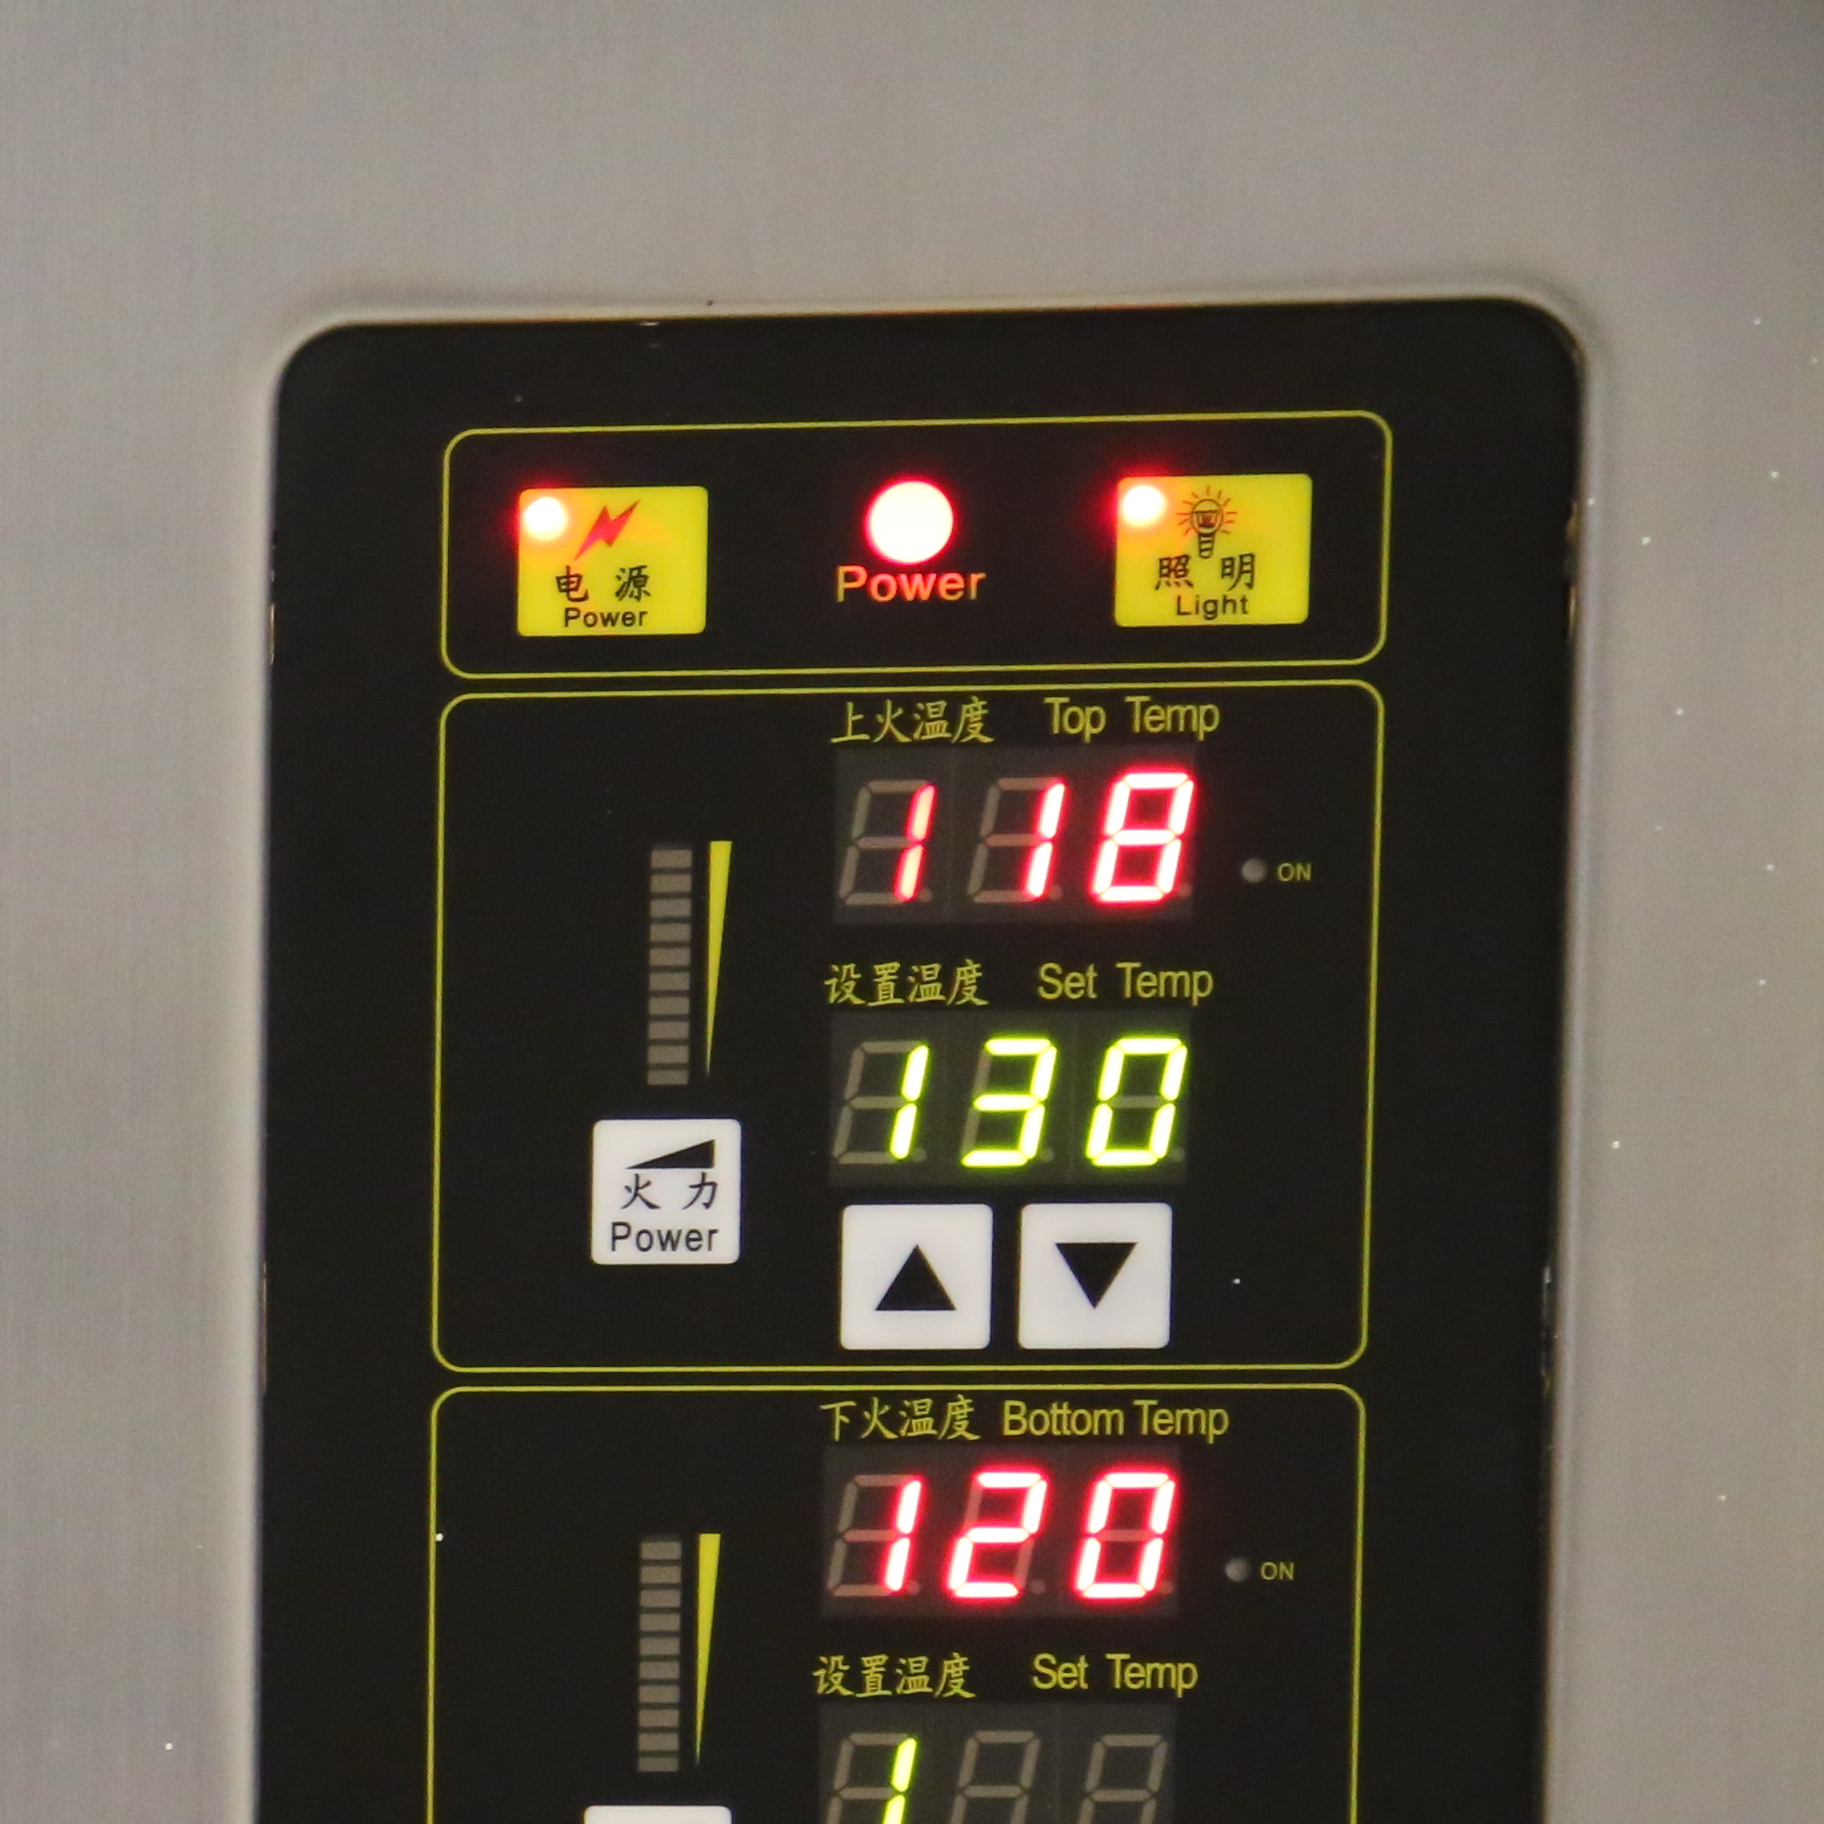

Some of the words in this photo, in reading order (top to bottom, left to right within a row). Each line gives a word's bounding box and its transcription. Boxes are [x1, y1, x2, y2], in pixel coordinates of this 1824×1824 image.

[555, 564, 651, 603] 电源
[837, 565, 986, 603] Power
[1154, 547, 1256, 592] 照明
[564, 607, 648, 628] Power
[1175, 594, 1249, 622] Light
[830, 695, 994, 744] 上火温度
[1043, 696, 1107, 744] Top
[1124, 695, 1220, 741] Temp
[897, 770, 1196, 903] 118
[1277, 862, 1312, 882] ON
[824, 963, 989, 1007] 设置温度
[1038, 962, 1098, 1000] Set
[1115, 961, 1214, 1006] Temp
[889, 1036, 1188, 1169] 130
[621, 1171, 718, 1210] 火力
[611, 1221, 718, 1253] Power
[819, 1401, 981, 1442] 下火温度
[1002, 1400, 1125, 1436] Bottom
[1133, 1399, 1229, 1445] Temp
[884, 1469, 1177, 1601] 120
[1260, 1561, 1294, 1581] ON
[812, 1652, 976, 1699] 设置温度
[1032, 1652, 1089, 1690] Set
[1105, 1653, 1198, 1698] Temp
